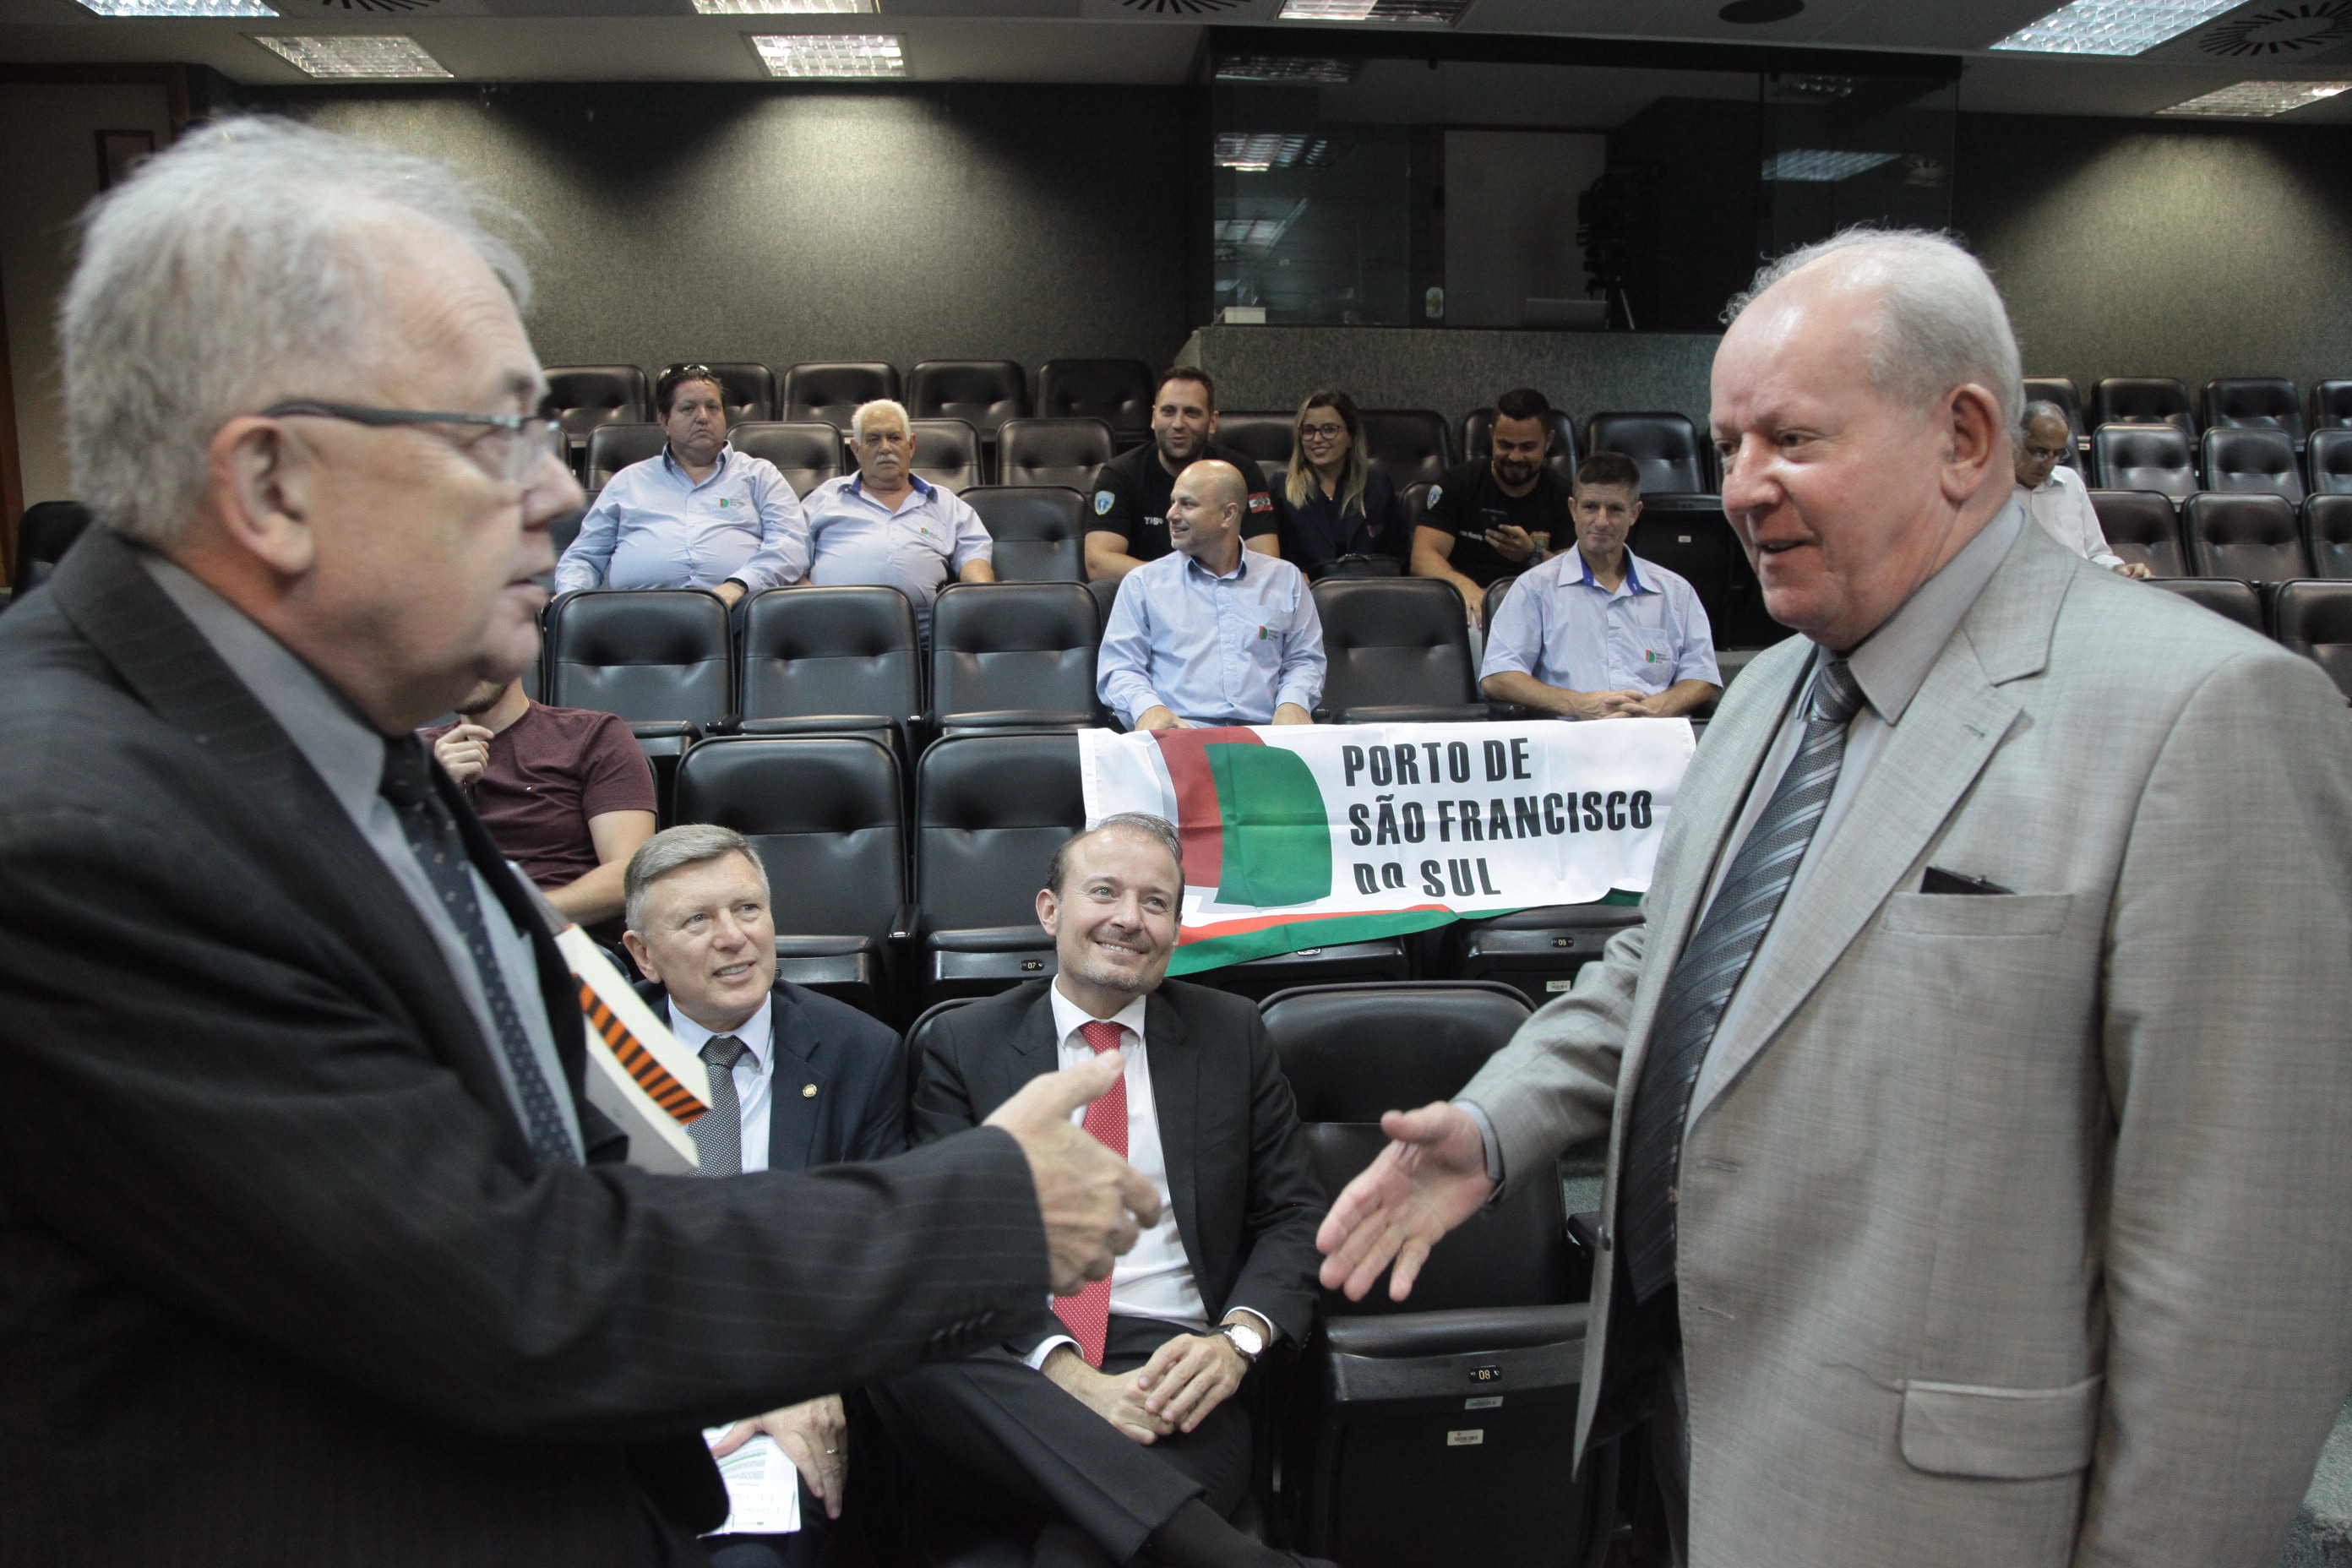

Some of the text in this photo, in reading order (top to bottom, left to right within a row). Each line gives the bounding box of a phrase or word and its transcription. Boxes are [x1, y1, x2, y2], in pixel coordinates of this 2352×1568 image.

[1342, 738, 1532, 787] PORTO DE
[1348, 790, 1652, 847] SÃO FRANCISCO
[1420, 858, 1502, 898] SUL
[1478, 1369, 1491, 1380] 08
